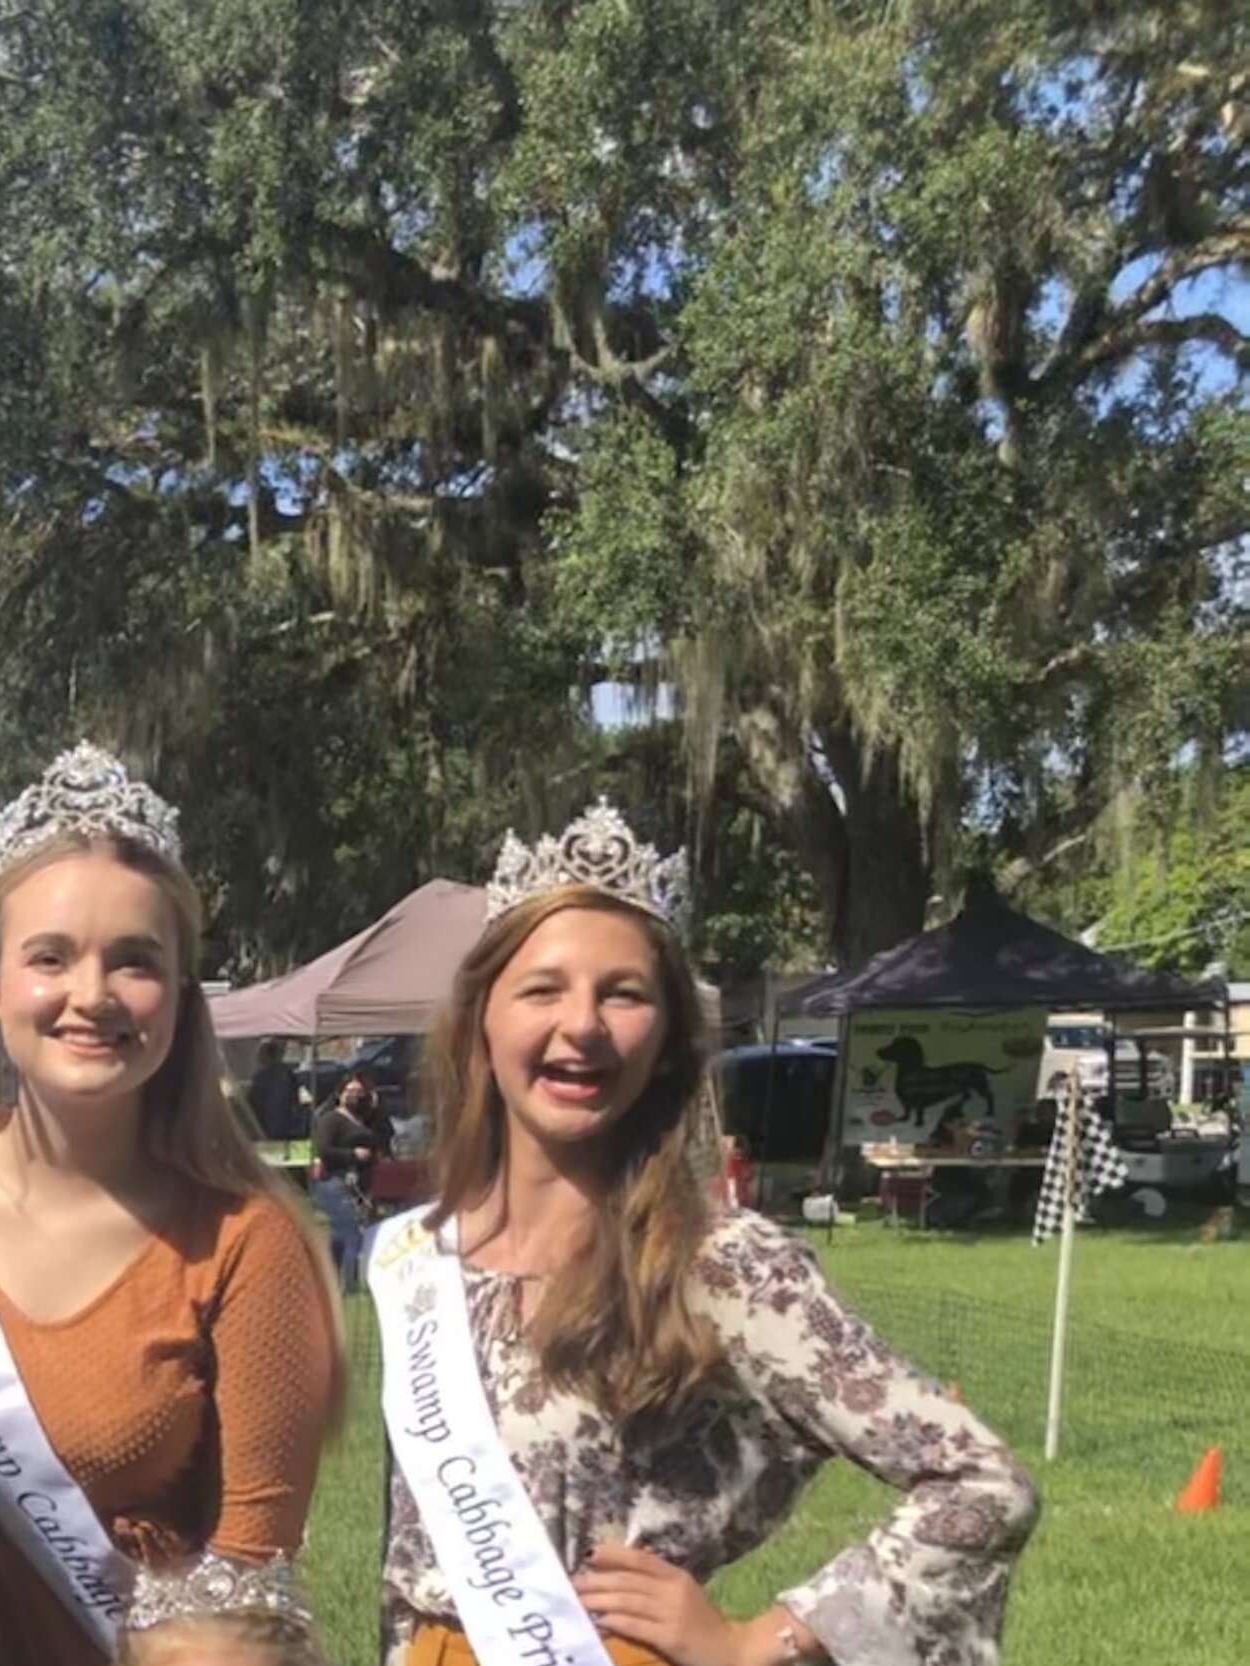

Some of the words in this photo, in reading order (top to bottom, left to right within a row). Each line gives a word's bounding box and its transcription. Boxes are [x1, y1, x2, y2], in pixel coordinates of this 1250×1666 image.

[16, 1490, 123, 1619] Cabbage
[406, 1319, 452, 1446] Swamp
[436, 1453, 525, 1609] Cabbage
